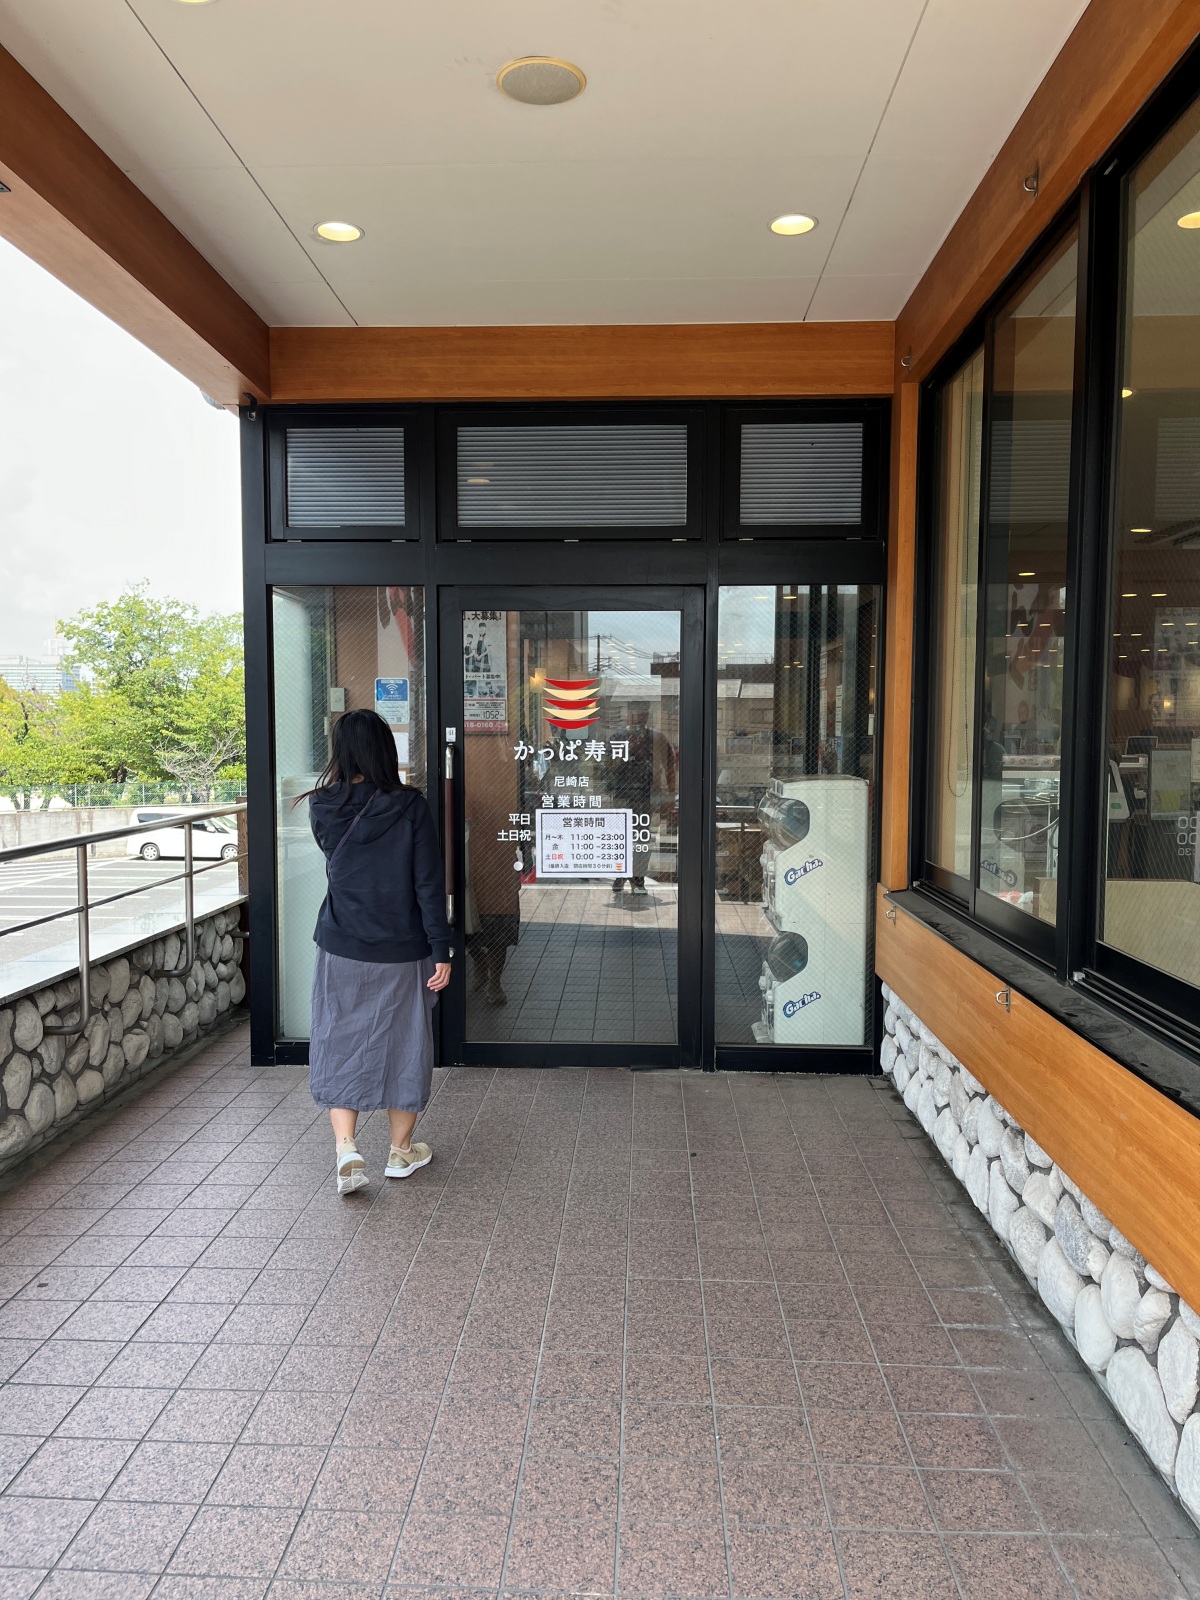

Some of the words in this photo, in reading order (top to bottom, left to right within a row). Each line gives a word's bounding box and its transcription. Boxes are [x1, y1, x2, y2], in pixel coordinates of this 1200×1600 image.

[513, 739, 630, 762] かっぱ寿司
[554, 776, 590, 788] 尼崎店
[541, 795, 602, 809] 営業時間
[508, 813, 531, 826] 平日
[562, 817, 606, 828] 営業時間
[497, 830, 532, 842] 土日祝
[570, 833, 594, 841] 11:00
[552, 843, 559, 851] 金
[570, 843, 594, 851] 11:00
[570, 853, 594, 861] 10:00
